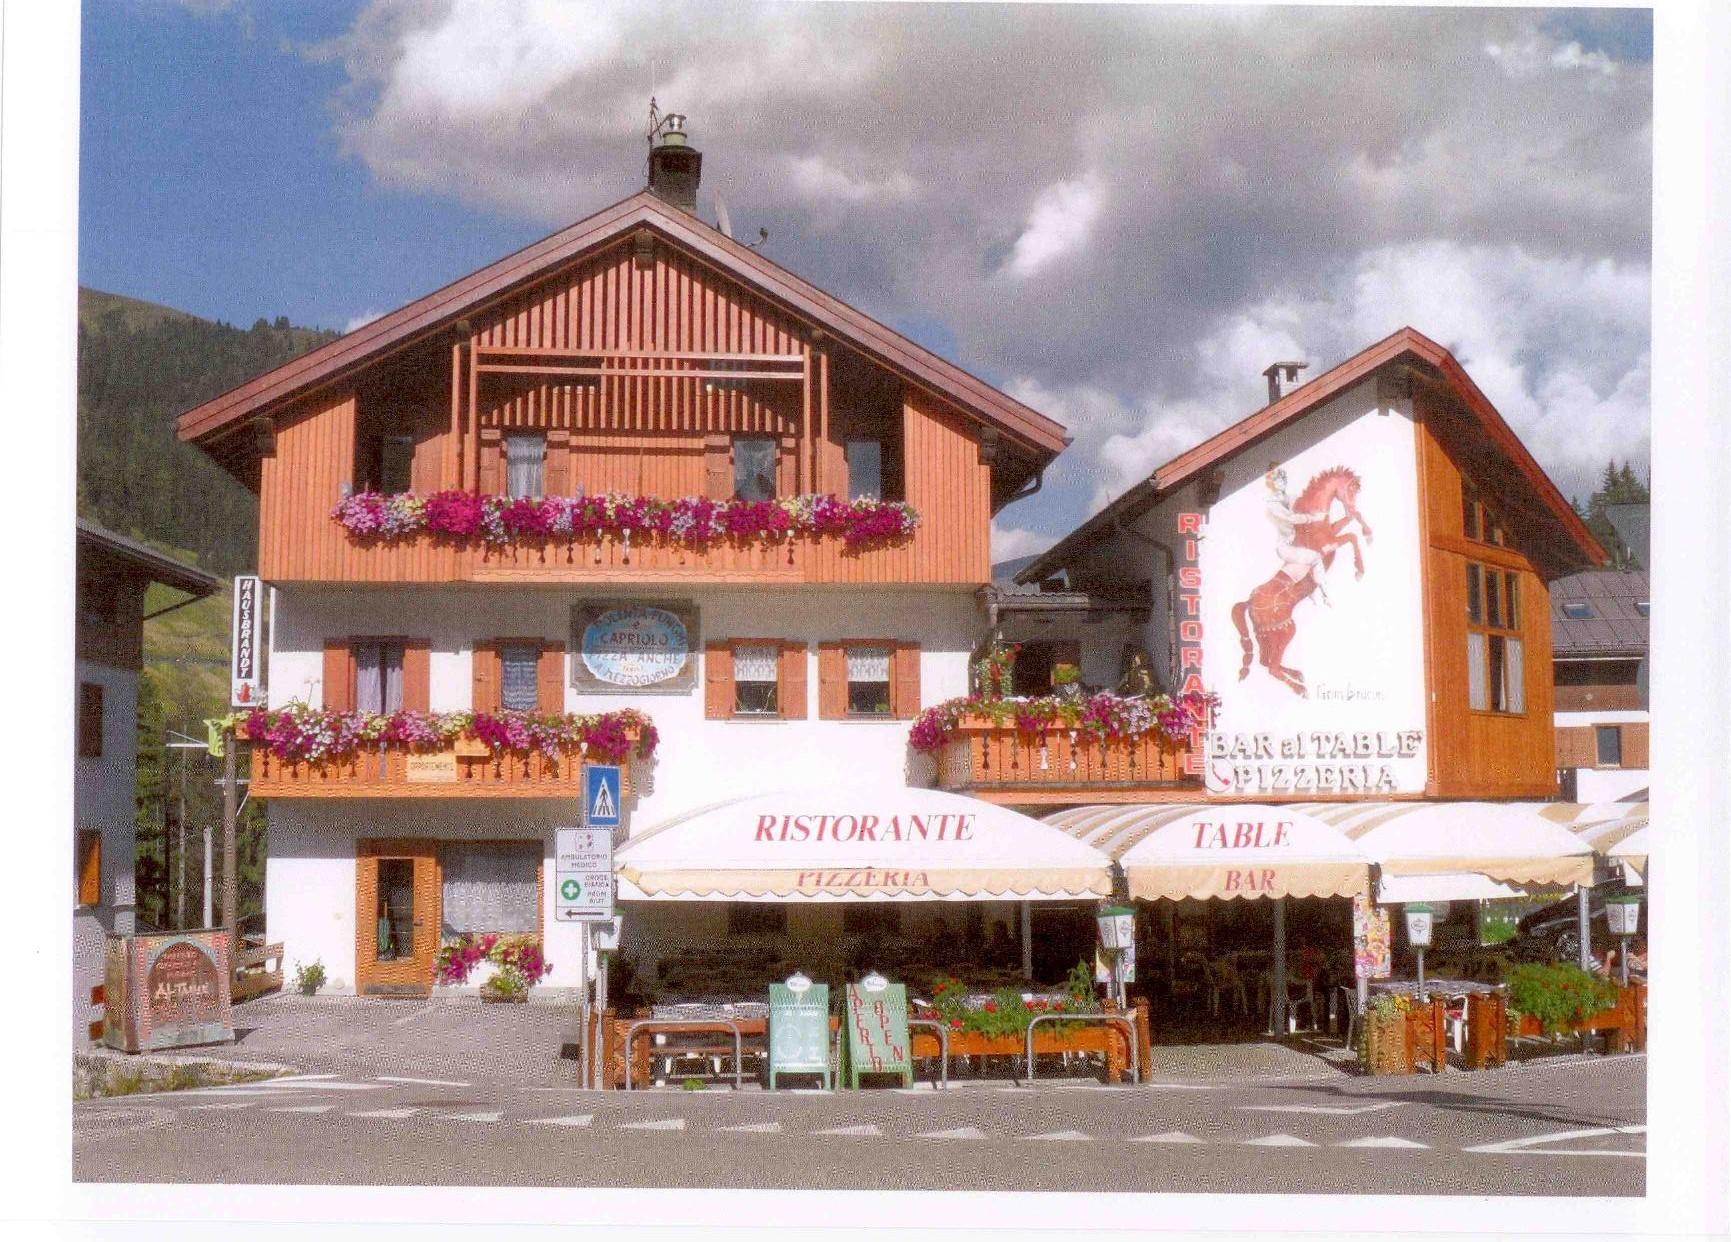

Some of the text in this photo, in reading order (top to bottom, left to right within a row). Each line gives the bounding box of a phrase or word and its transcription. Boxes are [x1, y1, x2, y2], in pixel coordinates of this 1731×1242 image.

[240, 579, 253, 679] HAUSBRANDT
[600, 632, 669, 646] CAPRIOLO
[638, 648, 682, 665] ANCHE
[1177, 513, 1208, 775] RISTORANTE
[1210, 731, 1275, 759] BAR
[1234, 764, 1398, 793] PIZZERIA
[754, 814, 976, 842] RISTORANTE
[1191, 821, 1294, 849] TABLE
[798, 871, 930, 887] PIZZERIA
[1224, 869, 1276, 891] BAR
[874, 1001, 903, 1062] OPEN
